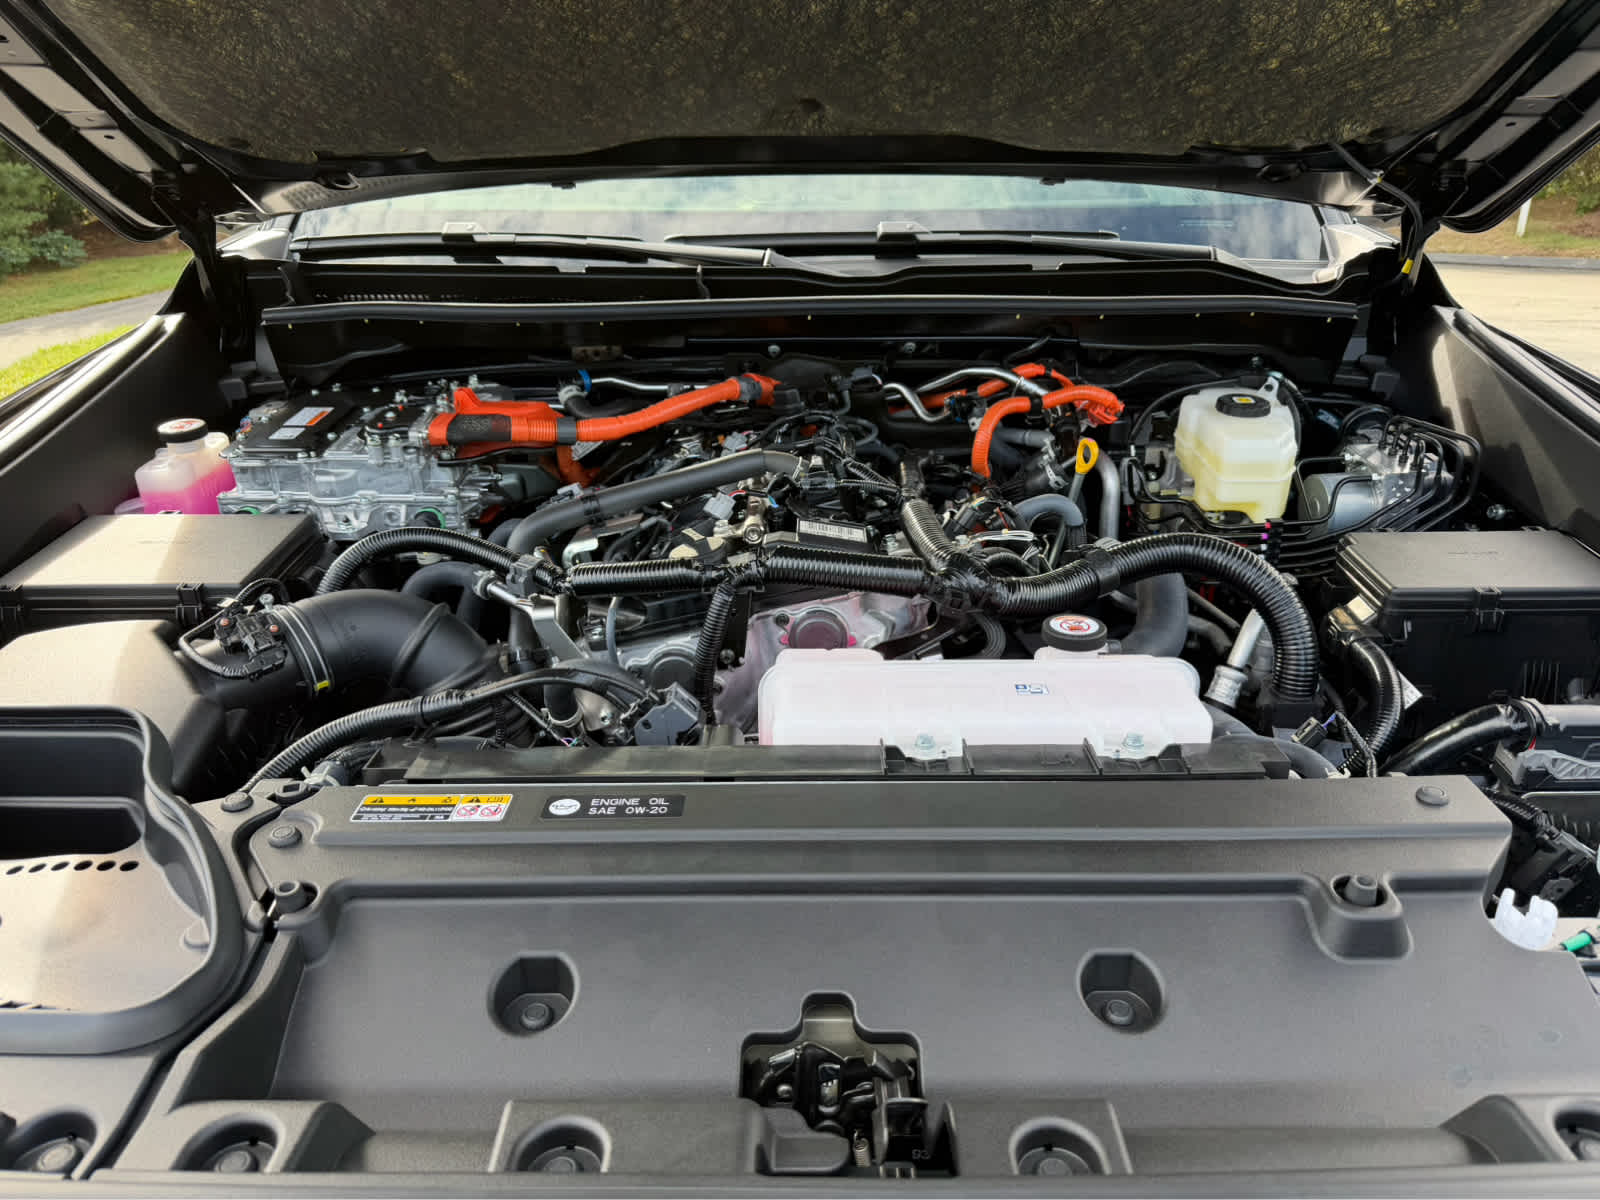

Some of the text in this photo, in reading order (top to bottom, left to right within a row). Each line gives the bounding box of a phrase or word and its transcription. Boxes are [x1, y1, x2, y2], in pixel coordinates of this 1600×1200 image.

[591, 797, 669, 806] ENGINE OIL
[588, 806, 668, 815] SAE 0W-20
